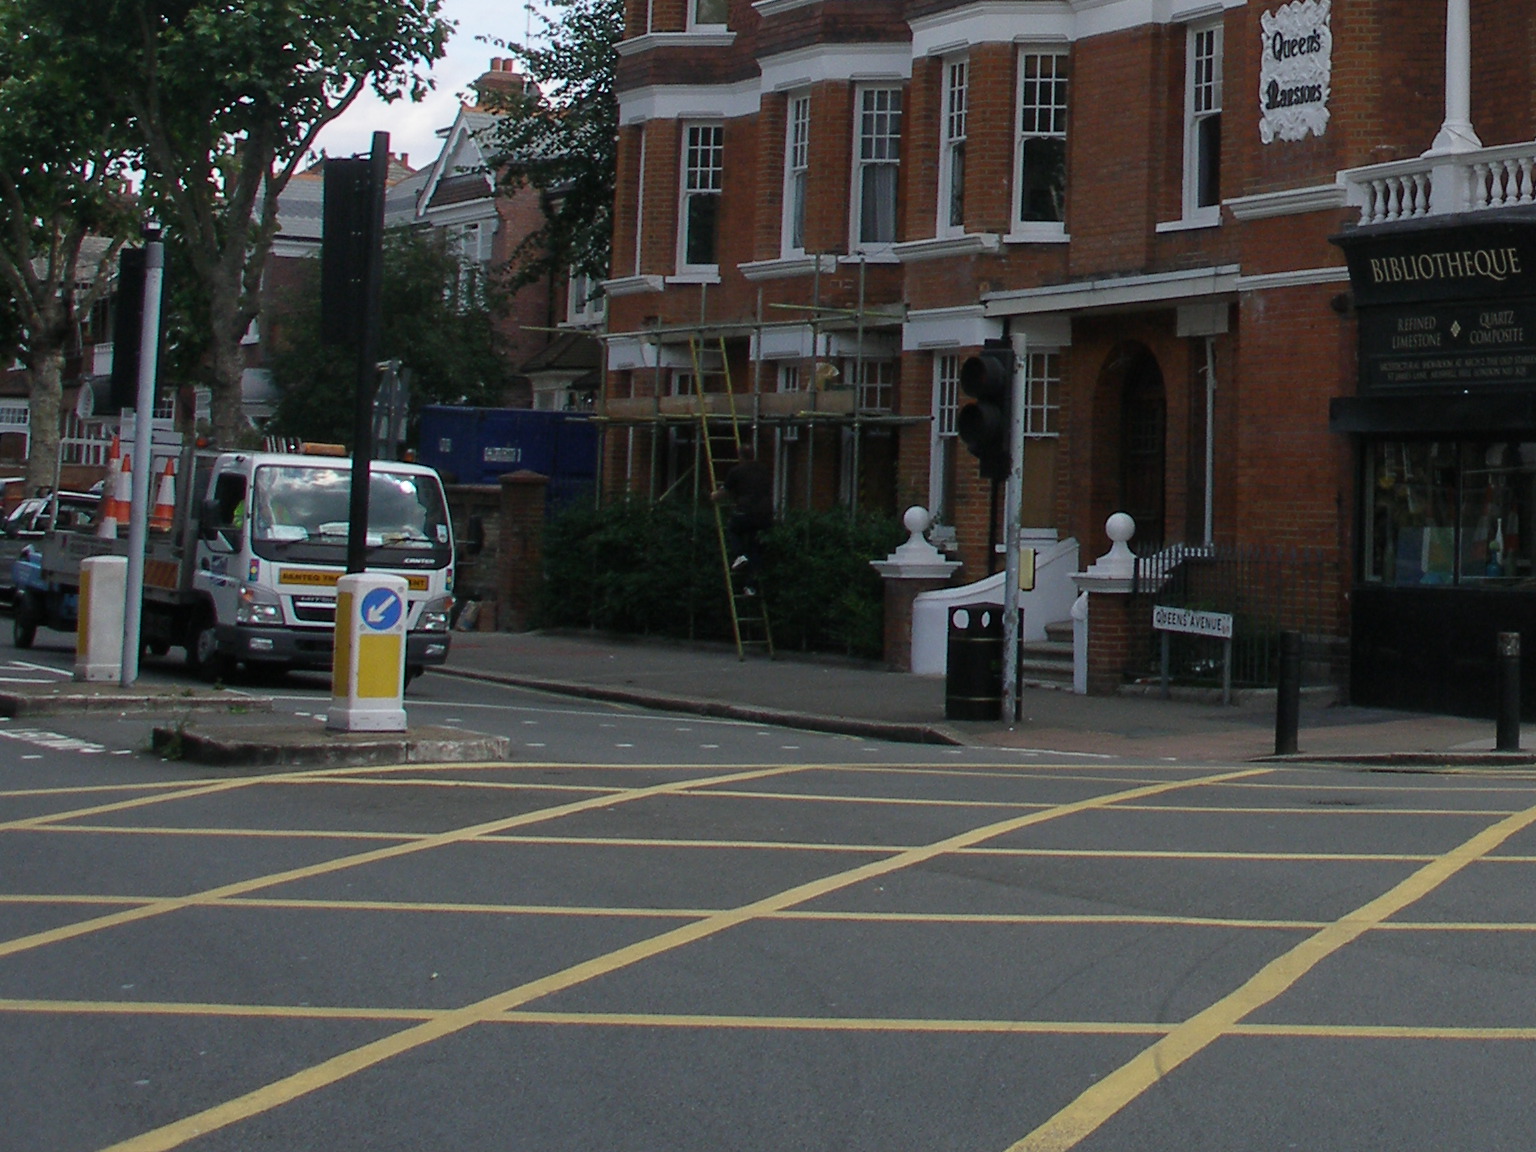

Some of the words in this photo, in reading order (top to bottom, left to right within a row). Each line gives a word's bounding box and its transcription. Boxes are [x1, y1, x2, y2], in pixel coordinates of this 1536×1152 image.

[1271, 29, 1321, 62] Queen's
[1370, 248, 1522, 283] BIBLIOTHEQUE
[1397, 316, 1437, 332] REFINED
[1479, 310, 1515, 329] QUARTZ
[1392, 333, 1442, 350] LIMESTONE
[1469, 328, 1524, 345] COMPOSITE
[1189, 615, 1223, 631] AVENUE
